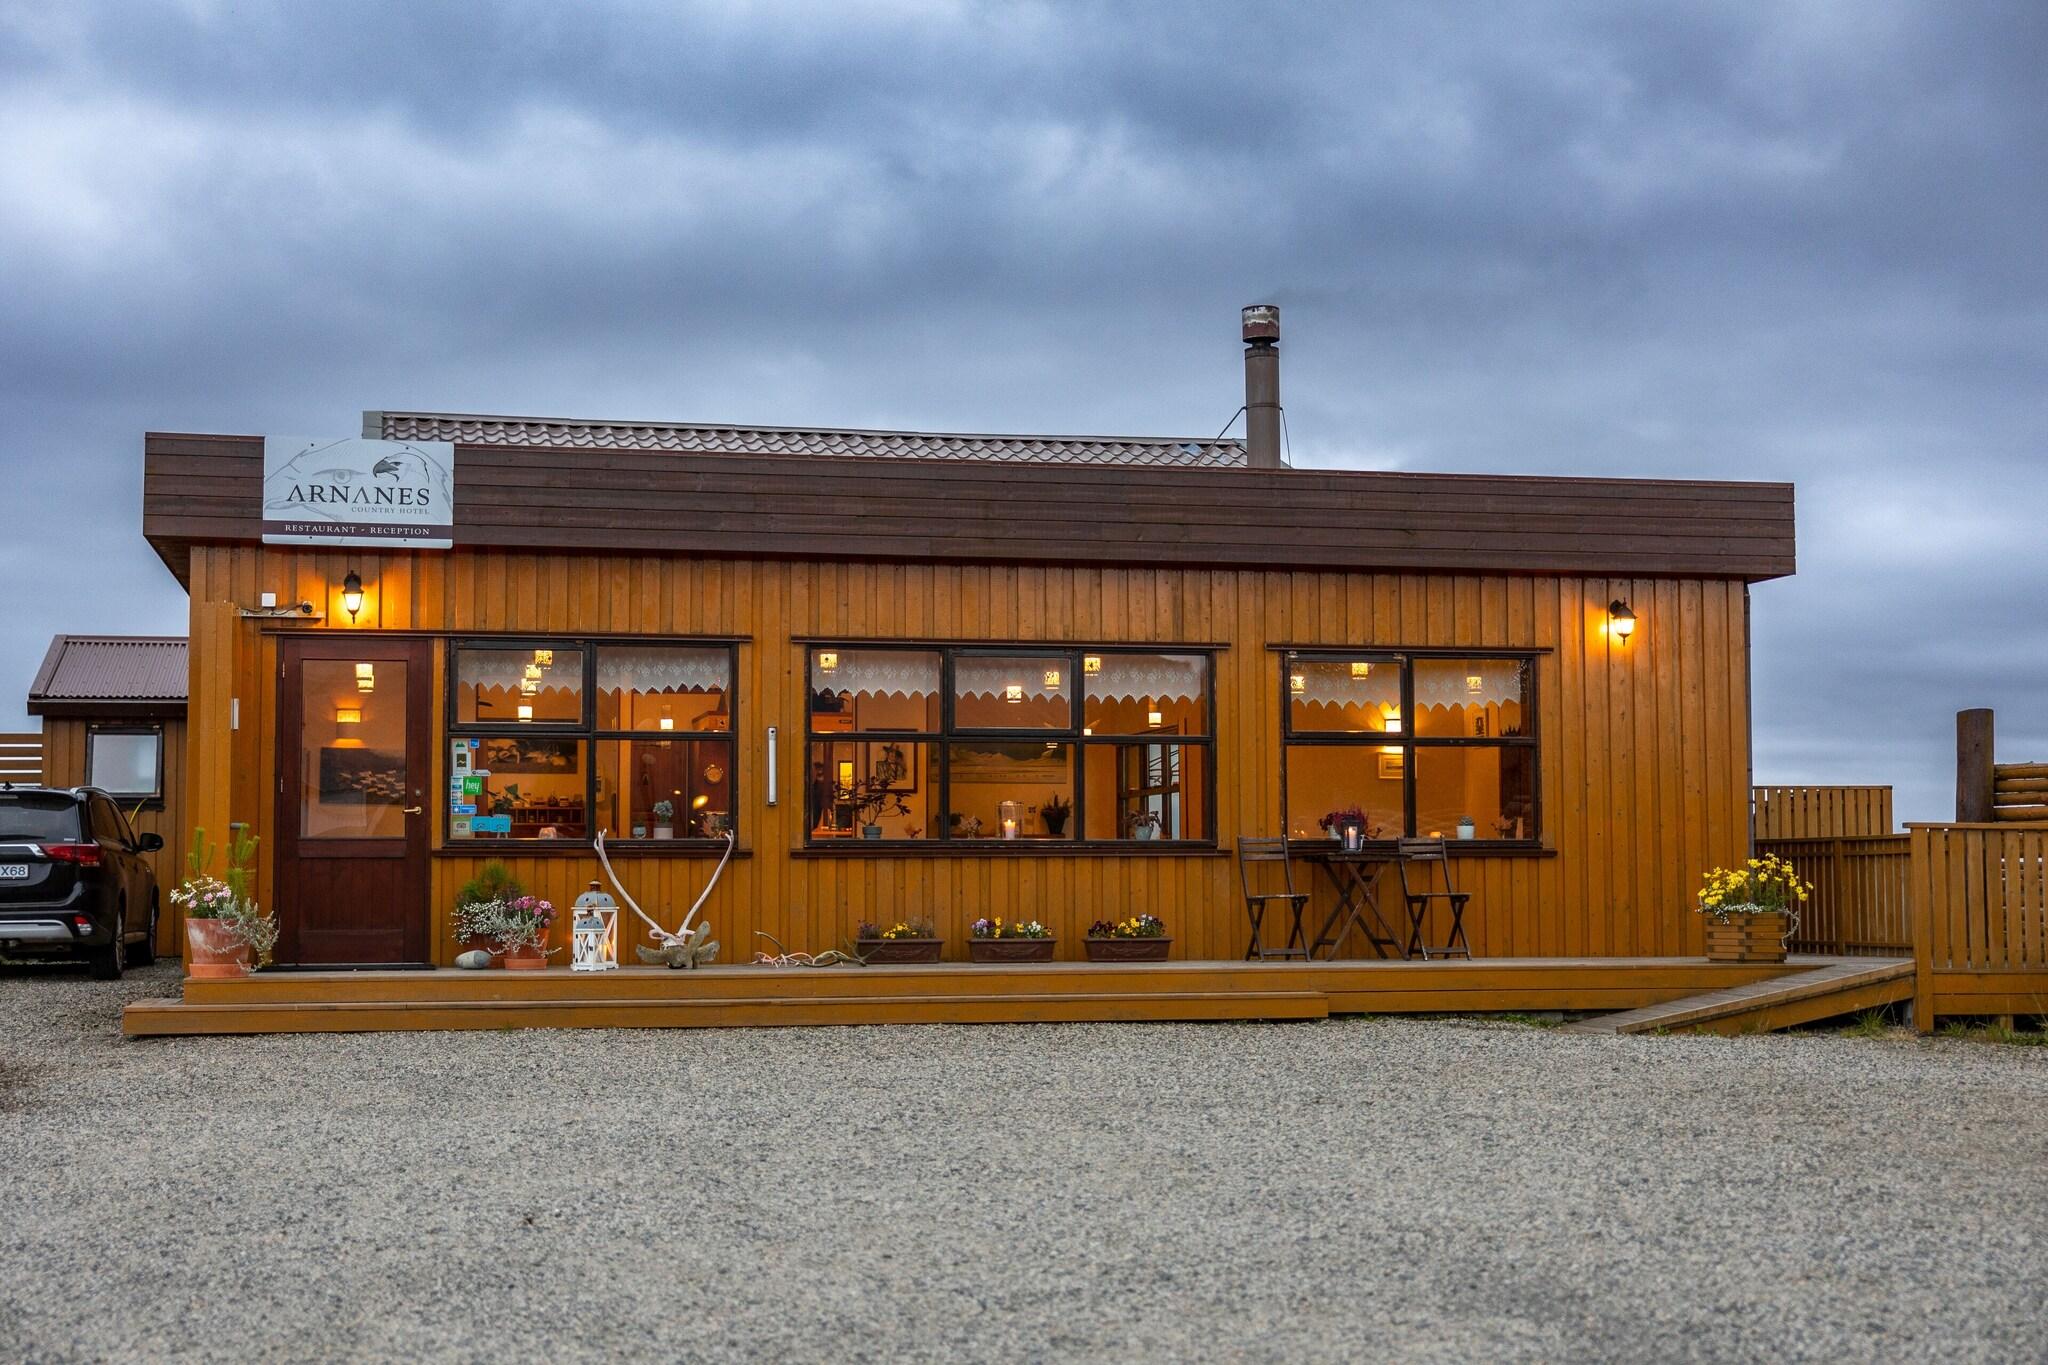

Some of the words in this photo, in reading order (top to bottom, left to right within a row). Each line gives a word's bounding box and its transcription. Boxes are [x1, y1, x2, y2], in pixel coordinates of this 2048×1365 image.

[287, 484, 430, 506] ARNANES
[351, 506, 395, 514] COUNTRY
[285, 524, 357, 534] RESTAURANT
[370, 527, 431, 535] RECEPTION
[465, 779, 480, 793] hey
[1, 866, 26, 876] X68
